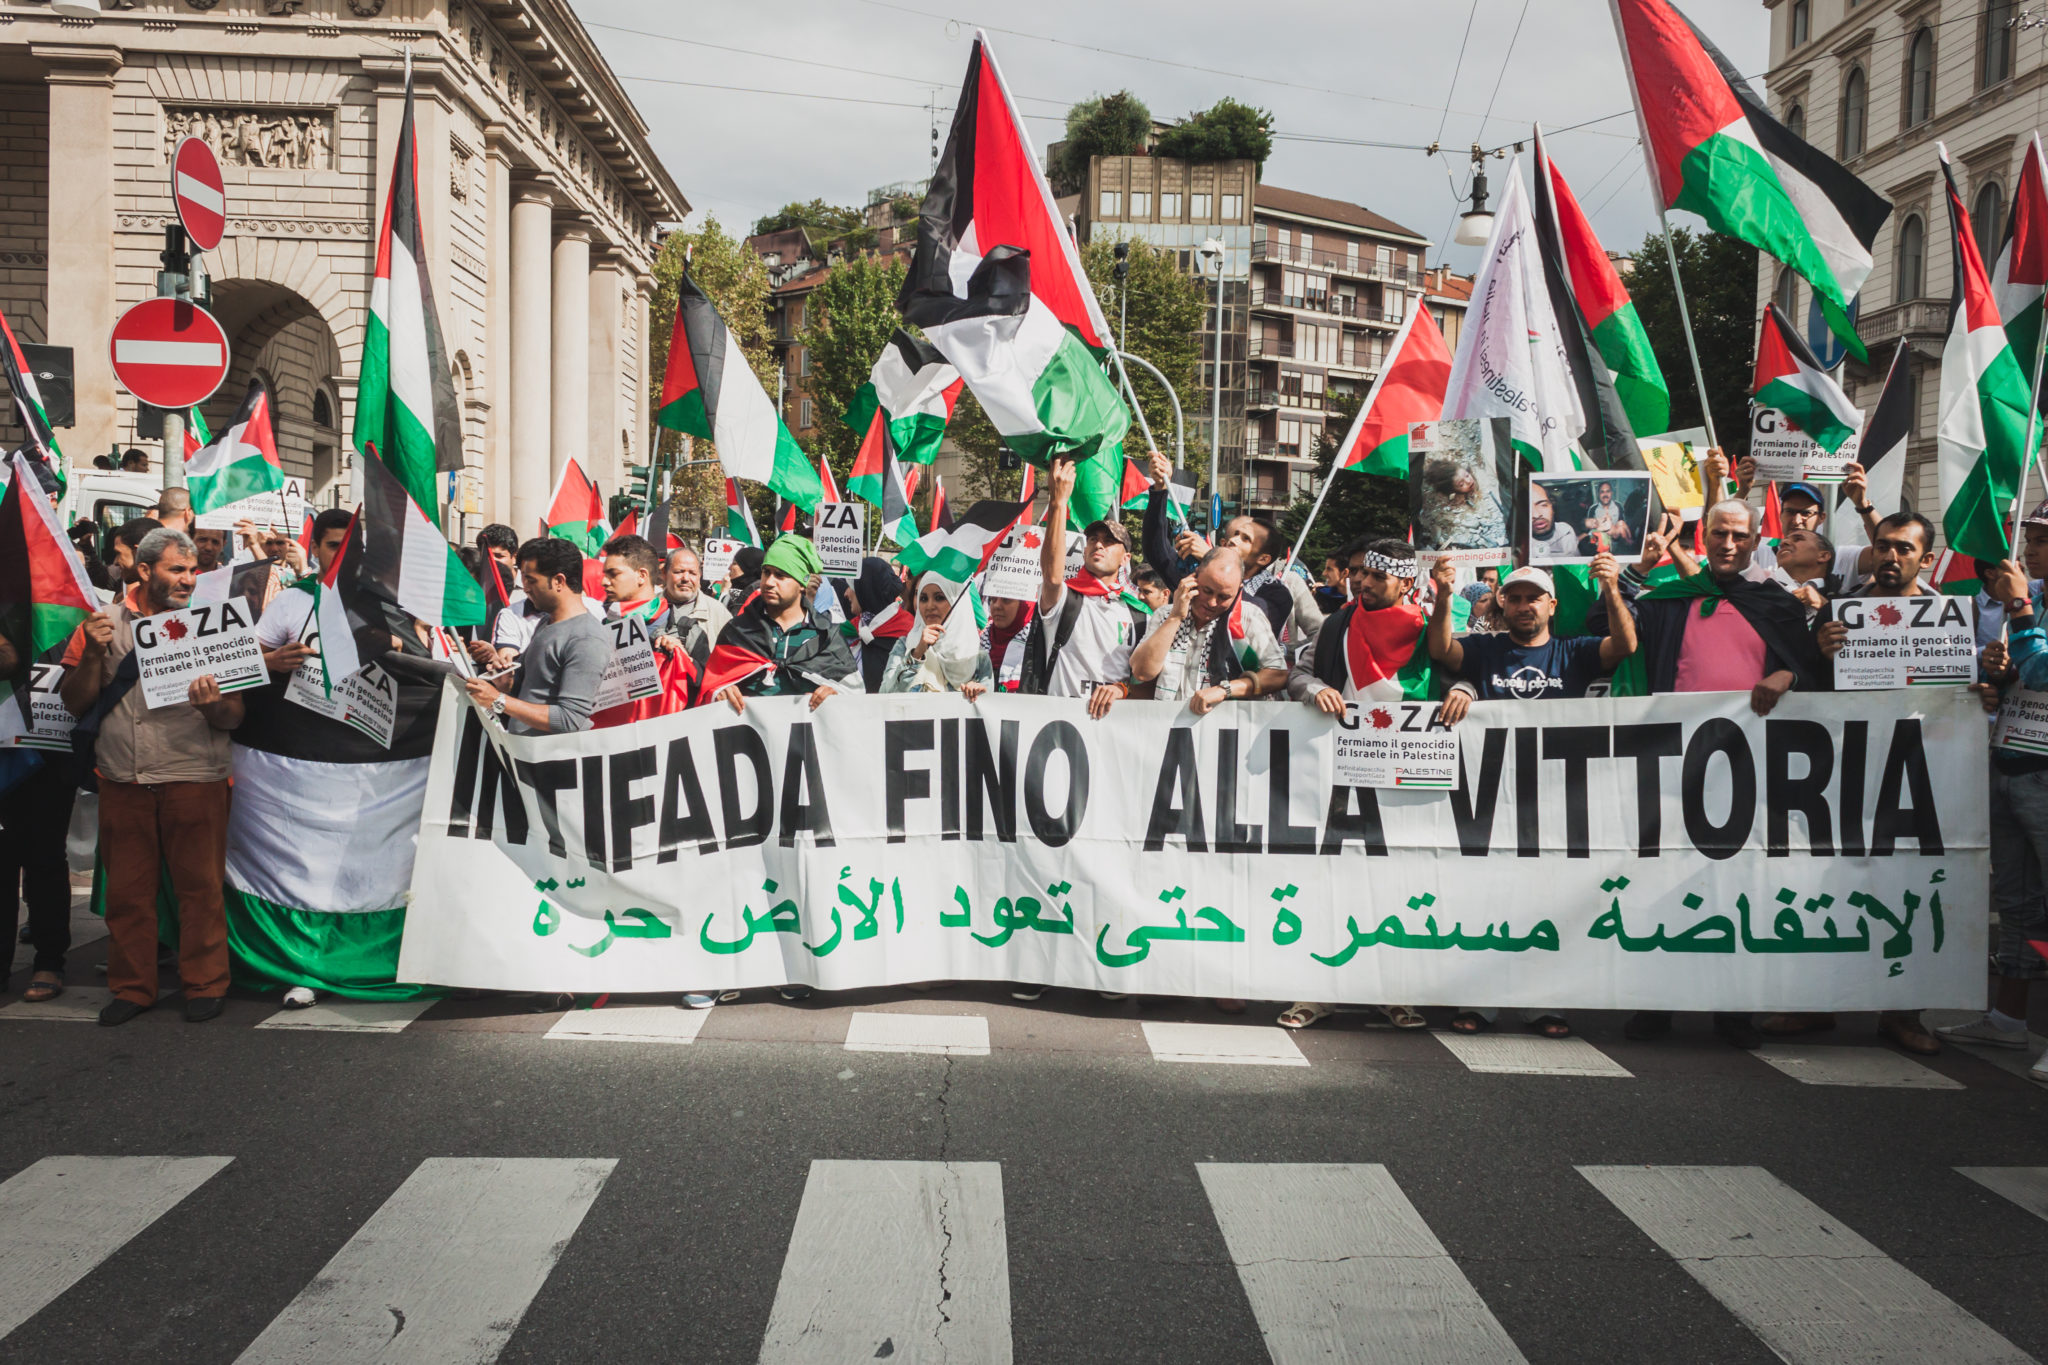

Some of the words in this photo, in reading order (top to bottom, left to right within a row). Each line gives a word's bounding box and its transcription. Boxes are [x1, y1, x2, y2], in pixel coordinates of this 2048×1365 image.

[1753, 439, 1799, 448] fermiamo
[1801, 440, 1808, 448] il
[1752, 449, 1761, 457] di
[1764, 449, 1797, 458] Israele
[1800, 450, 1808, 458] in
[820, 535, 860, 545] genocidio
[820, 545, 860, 554] Palestina
[992, 554, 1034, 566] fermiamo
[1422, 551, 1507, 563] #stoombingGaza
[1000, 564, 1031, 575] Israele
[1034, 570, 1041, 578] in
[1901, 635, 1909, 646] il
[1912, 634, 1972, 648] genocidio
[140, 650, 191, 668] fermiamo
[192, 646, 200, 657] il
[203, 636, 255, 654] genocidio
[620, 649, 651, 667] genocidio
[1838, 649, 1849, 659] di
[1854, 648, 1896, 658] Israele
[1900, 648, 1911, 658] in
[1915, 646, 1973, 657] Palestina
[143, 668, 152, 679] di
[155, 662, 193, 677] Israele
[195, 658, 206, 668] in
[208, 647, 258, 665] Palestina
[623, 661, 654, 675] Palestina
[1905, 665, 1971, 674] PALESTINE
[211, 663, 260, 679] ALESTINE
[1492, 674, 1527, 692] lonely
[295, 670, 305, 680] di
[346, 687, 355, 699] in
[357, 695, 392, 725] Palestina
[357, 686, 393, 715] genocidio
[2007, 708, 2016, 718] in
[1337, 736, 1388, 748] fermiamo
[1391, 739, 1398, 748] il
[1401, 739, 1455, 750] genocidio
[1337, 748, 1347, 757] di
[1350, 748, 1386, 759] Israele
[1390, 750, 1399, 759] in
[1403, 751, 1455, 760] Palestina
[1395, 768, 1453, 776] PALESTINE
[447, 705, 836, 873] INTIFADA
[884, 717, 1090, 848] FINO
[1142, 726, 1389, 857] ALLA
[1447, 717, 1945, 860] VITTORIA
[699, 865, 905, 958] الأرض
[939, 880, 1075, 948] تعود
[1096, 885, 1246, 968] حتى
[1270, 882, 1560, 967] مستمرة
